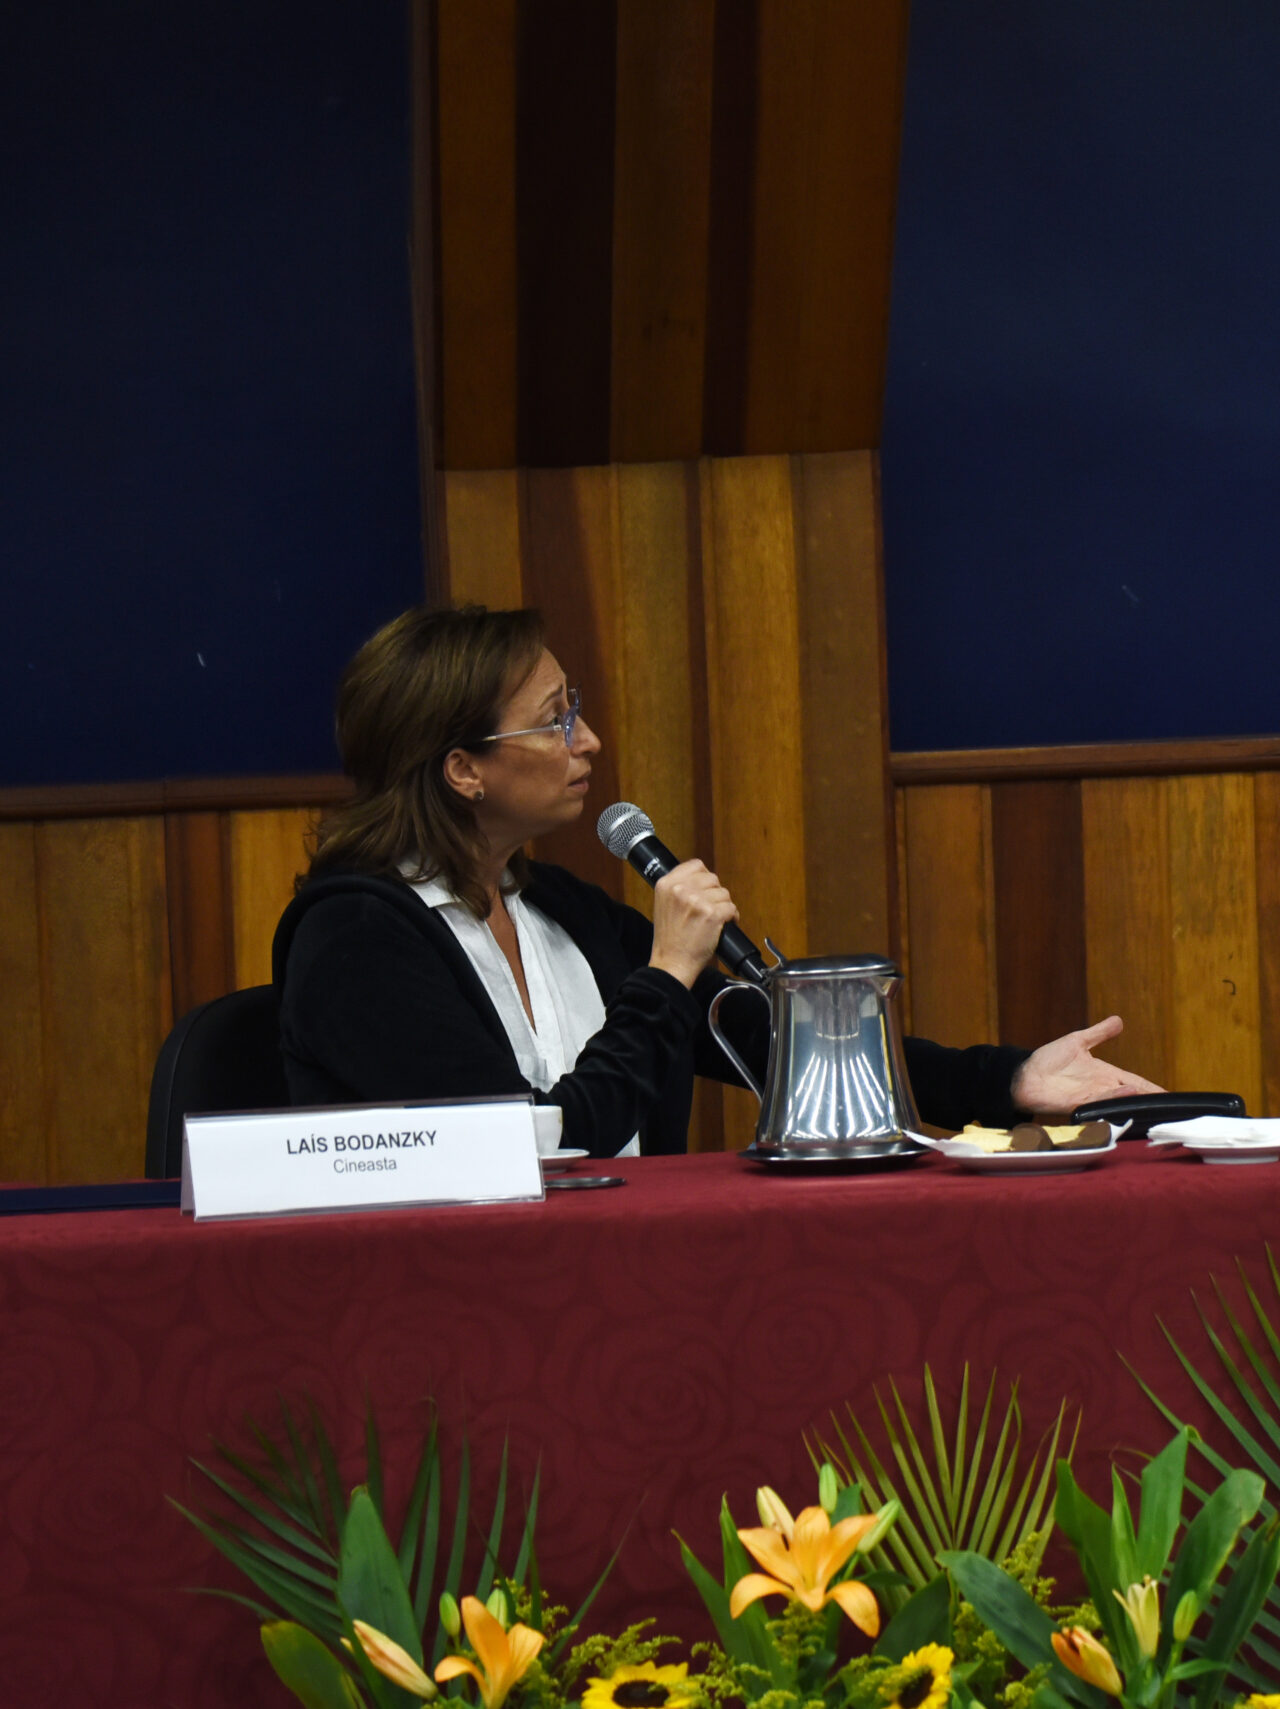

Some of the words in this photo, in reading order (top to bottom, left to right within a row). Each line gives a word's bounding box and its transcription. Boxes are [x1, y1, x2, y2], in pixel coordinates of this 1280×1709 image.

[286, 1134, 328, 1155] LAÍS
[334, 1130, 437, 1152] BODANZKY
[333, 1157, 397, 1173] Cineasta
